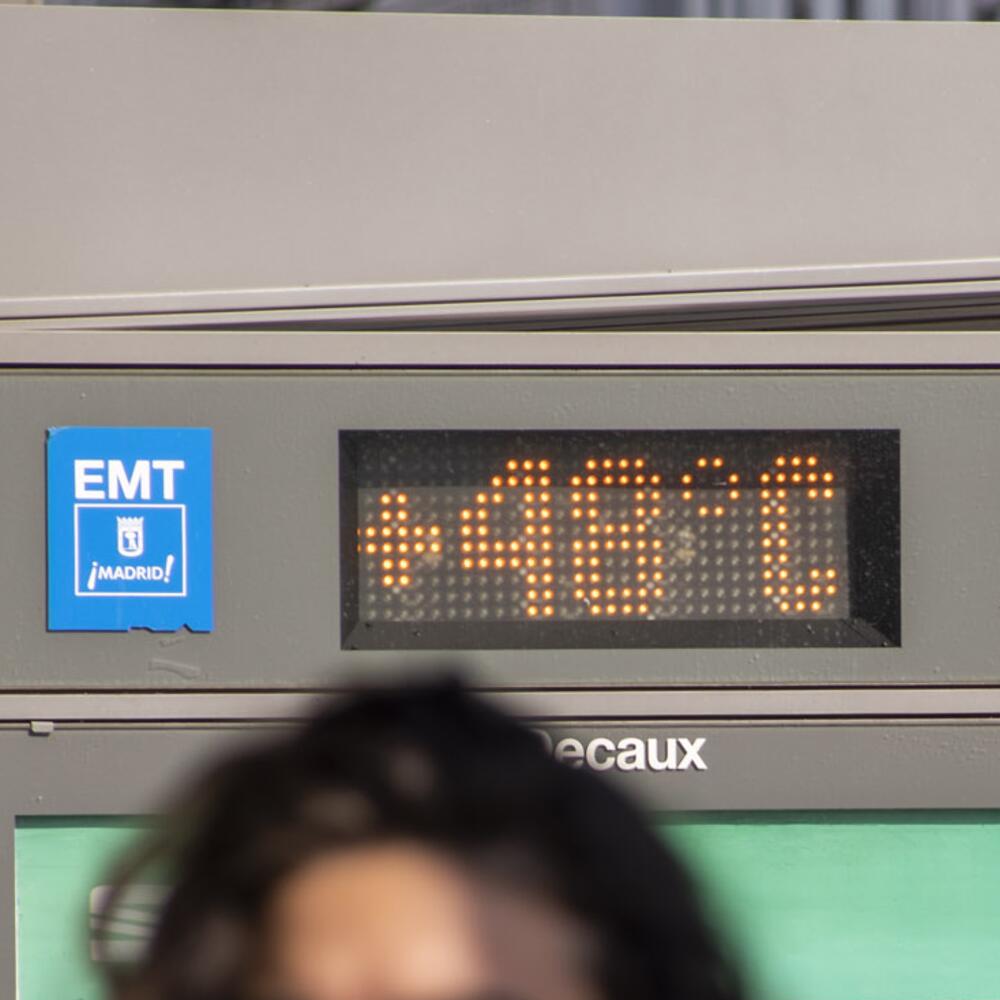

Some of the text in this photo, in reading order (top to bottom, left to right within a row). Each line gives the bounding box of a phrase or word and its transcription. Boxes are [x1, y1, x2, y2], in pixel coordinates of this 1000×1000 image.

[74, 458, 185, 500] EMT
[87, 554, 175, 590] ¡MADRID!
[532, 729, 708, 772] ecaux
